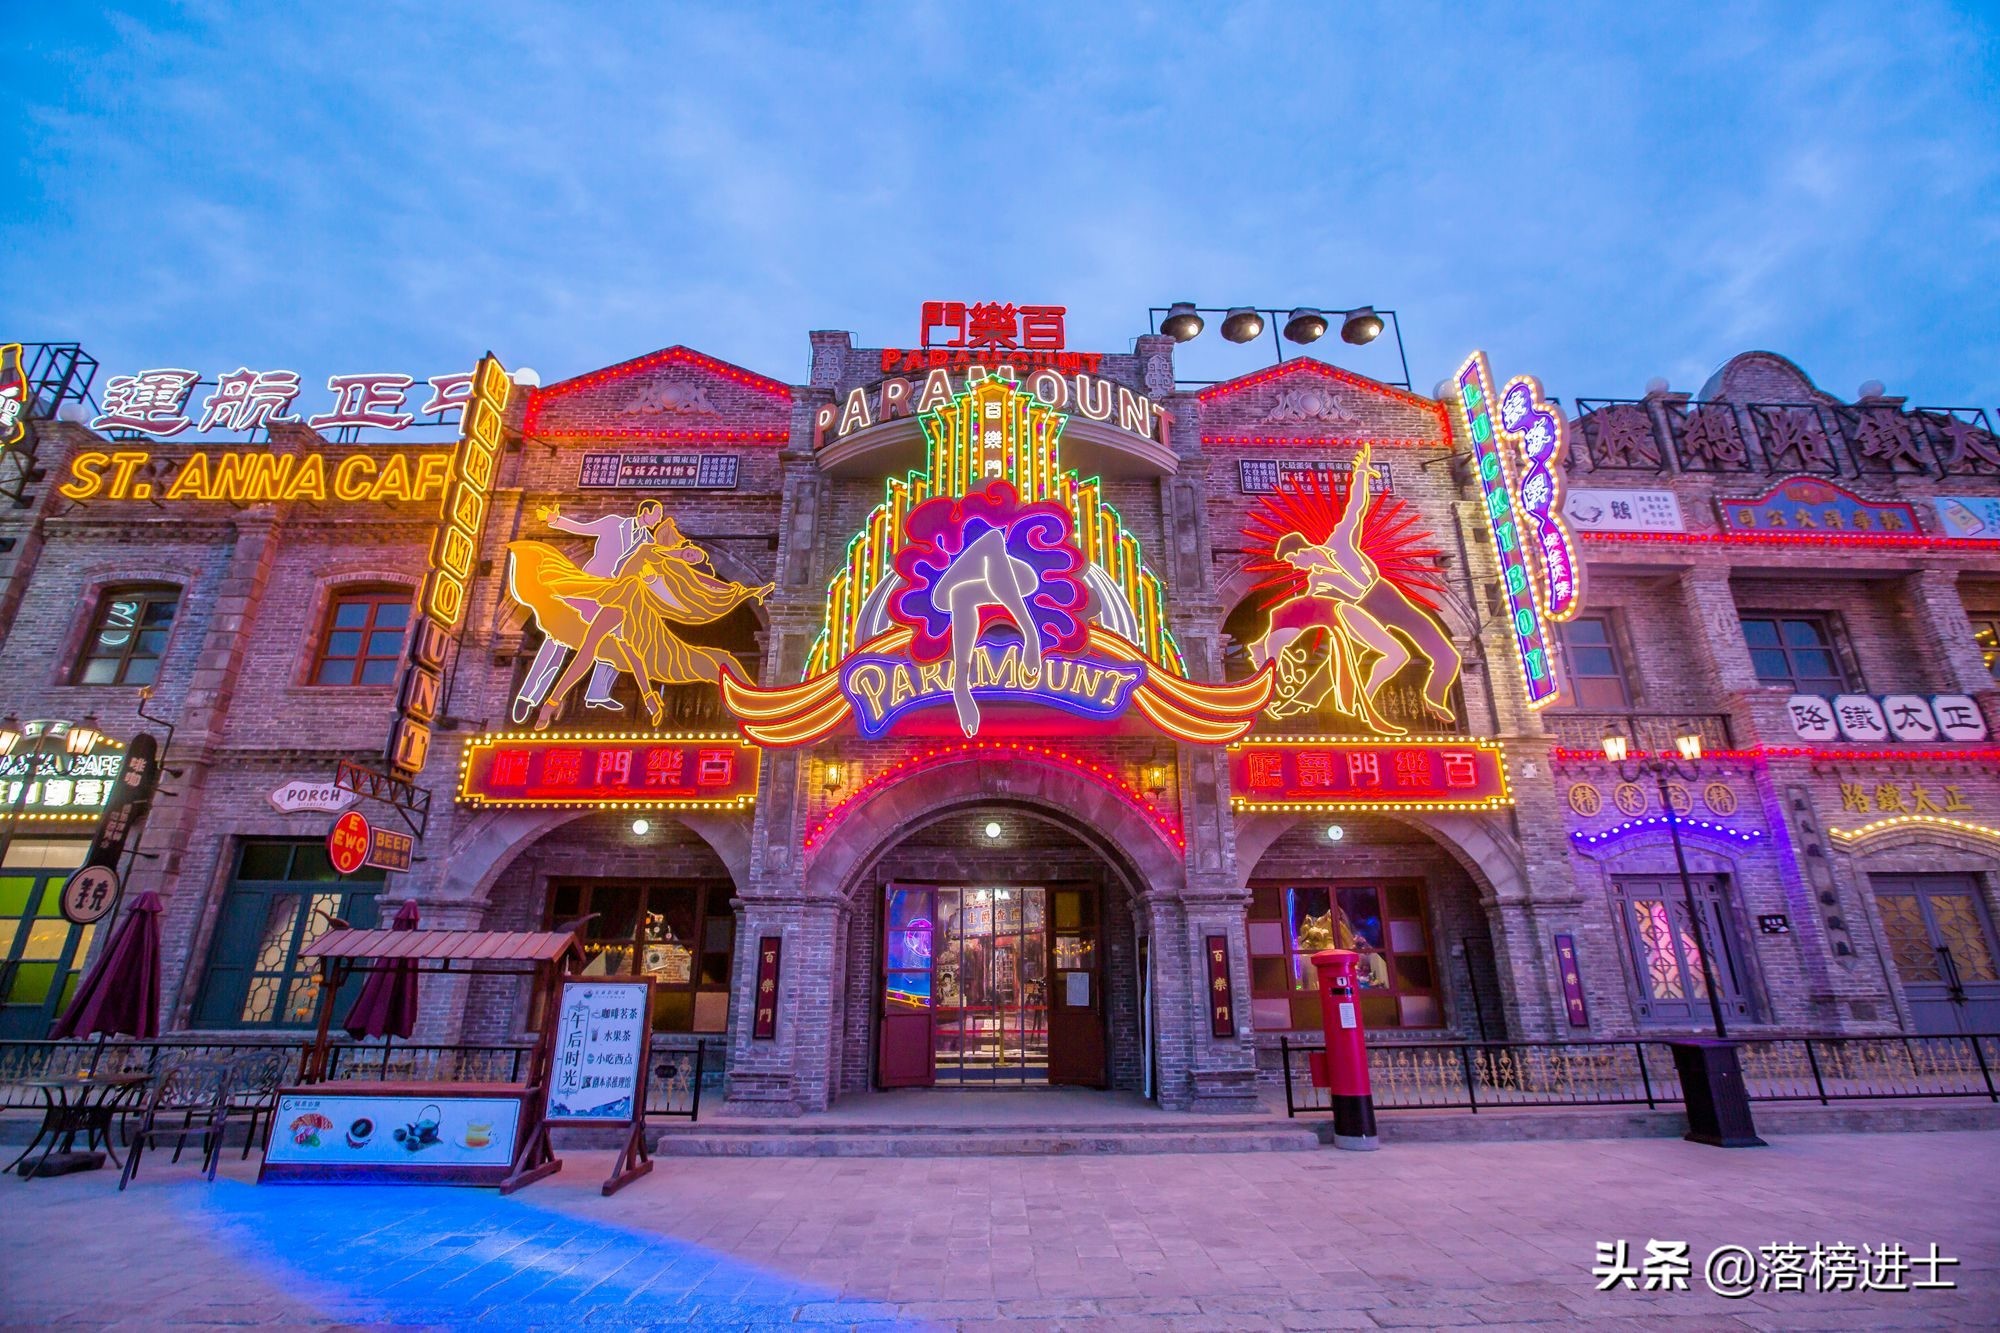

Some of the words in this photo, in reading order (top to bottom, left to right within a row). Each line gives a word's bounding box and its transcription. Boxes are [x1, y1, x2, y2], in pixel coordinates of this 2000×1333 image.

[881, 348, 1103, 374] PARAMOUNT
[983, 401, 1003, 480] 百樂門
[59, 451, 152, 500] ST.
[167, 453, 327, 500] ANNA
[333, 454, 456, 500] CAF
[1462, 383, 1512, 552] LUCKY
[1507, 564, 1545, 681] BOY
[402, 361, 508, 766] PARAMOUNT
[287, 789, 341, 802] PORCH
[349, 814, 361, 831] E
[333, 829, 367, 854] EWO
[340, 851, 352, 869] O
[375, 832, 411, 852] BEER
[759, 950, 775, 1023] 百樂門
[1213, 949, 1230, 1021] 百樂門
[1560, 947, 1581, 1012] 百樂門
[562, 1012, 585, 1087] 午后时光
[604, 1030, 631, 1041] 水果茶
[596, 1053, 633, 1065] 小吃西点
